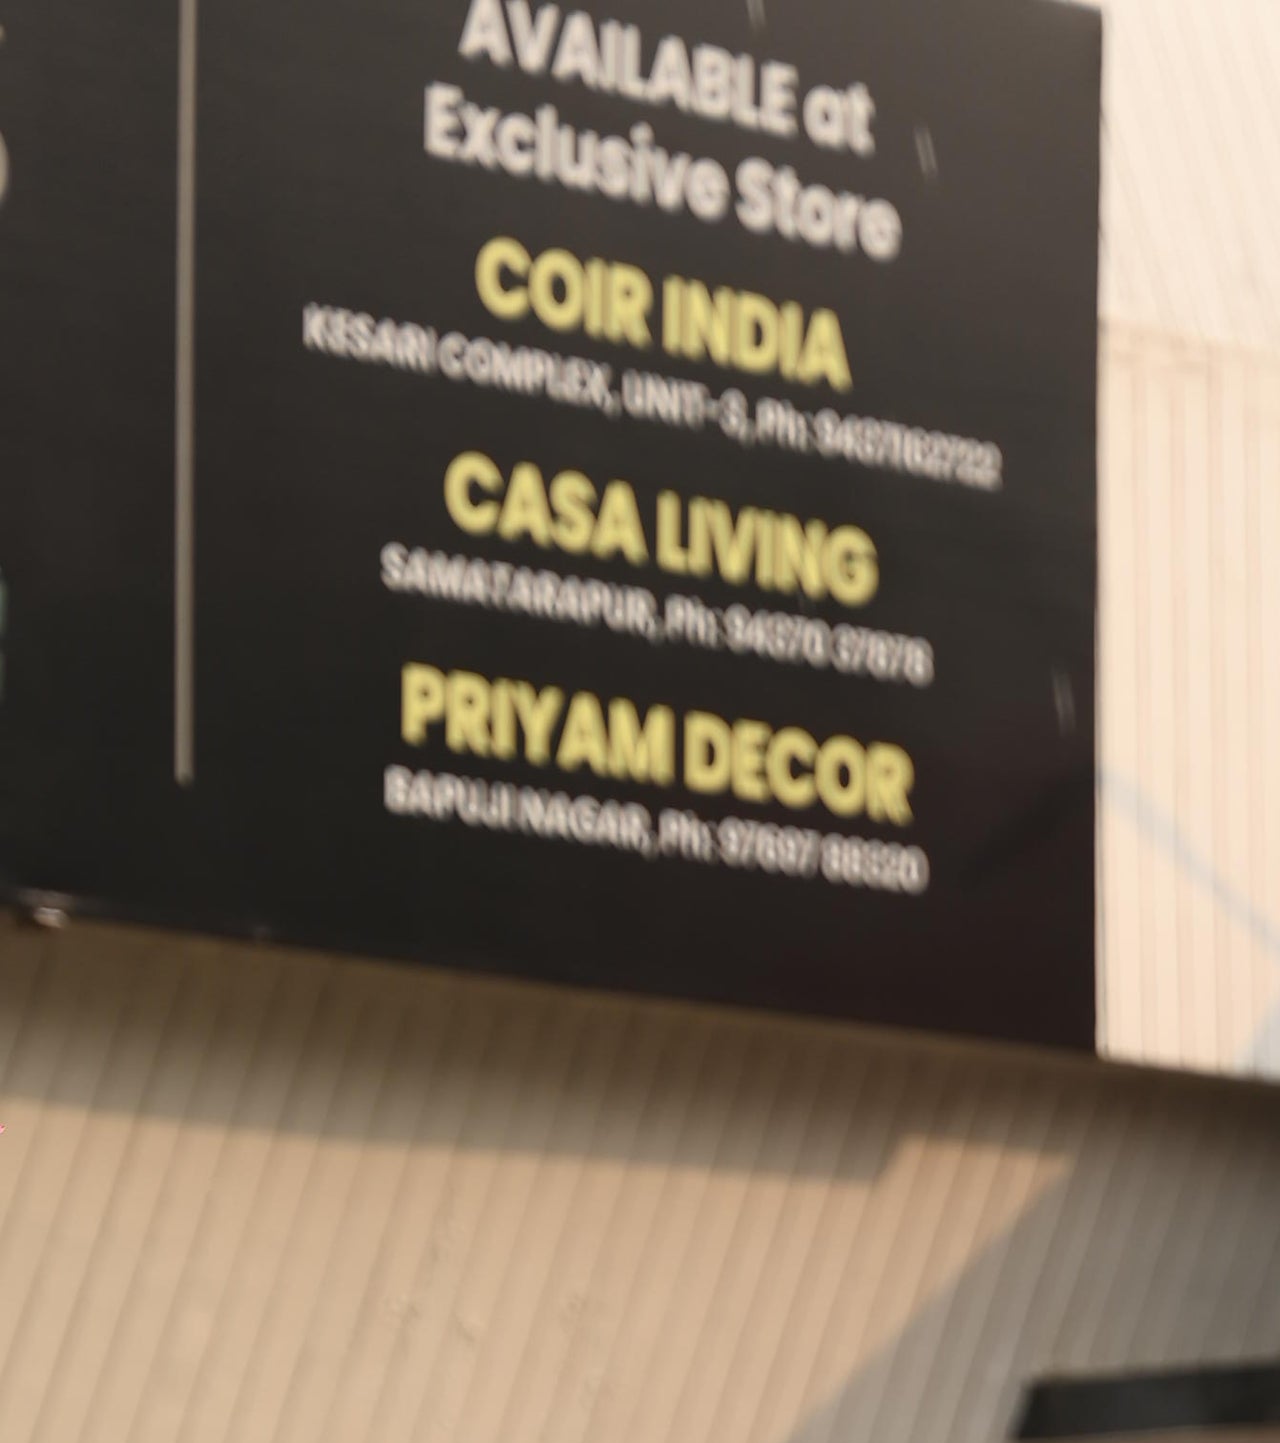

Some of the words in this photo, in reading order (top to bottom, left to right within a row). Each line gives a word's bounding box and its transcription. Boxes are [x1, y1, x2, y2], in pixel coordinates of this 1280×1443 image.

[459, 0, 798, 136] AVAILABLE
[803, 82, 876, 155] at
[424, 83, 730, 219] Exclusive
[735, 158, 902, 259] Store
[437, 332, 621, 413] COMPLEX,
[475, 237, 653, 346] COIR
[662, 276, 852, 390] INDIA
[444, 452, 647, 563] CASA
[656, 491, 878, 605] LIVING
[384, 765, 519, 828] BAPUJI
[401, 663, 675, 784] PRIYAM
[684, 711, 914, 824] DECOR
